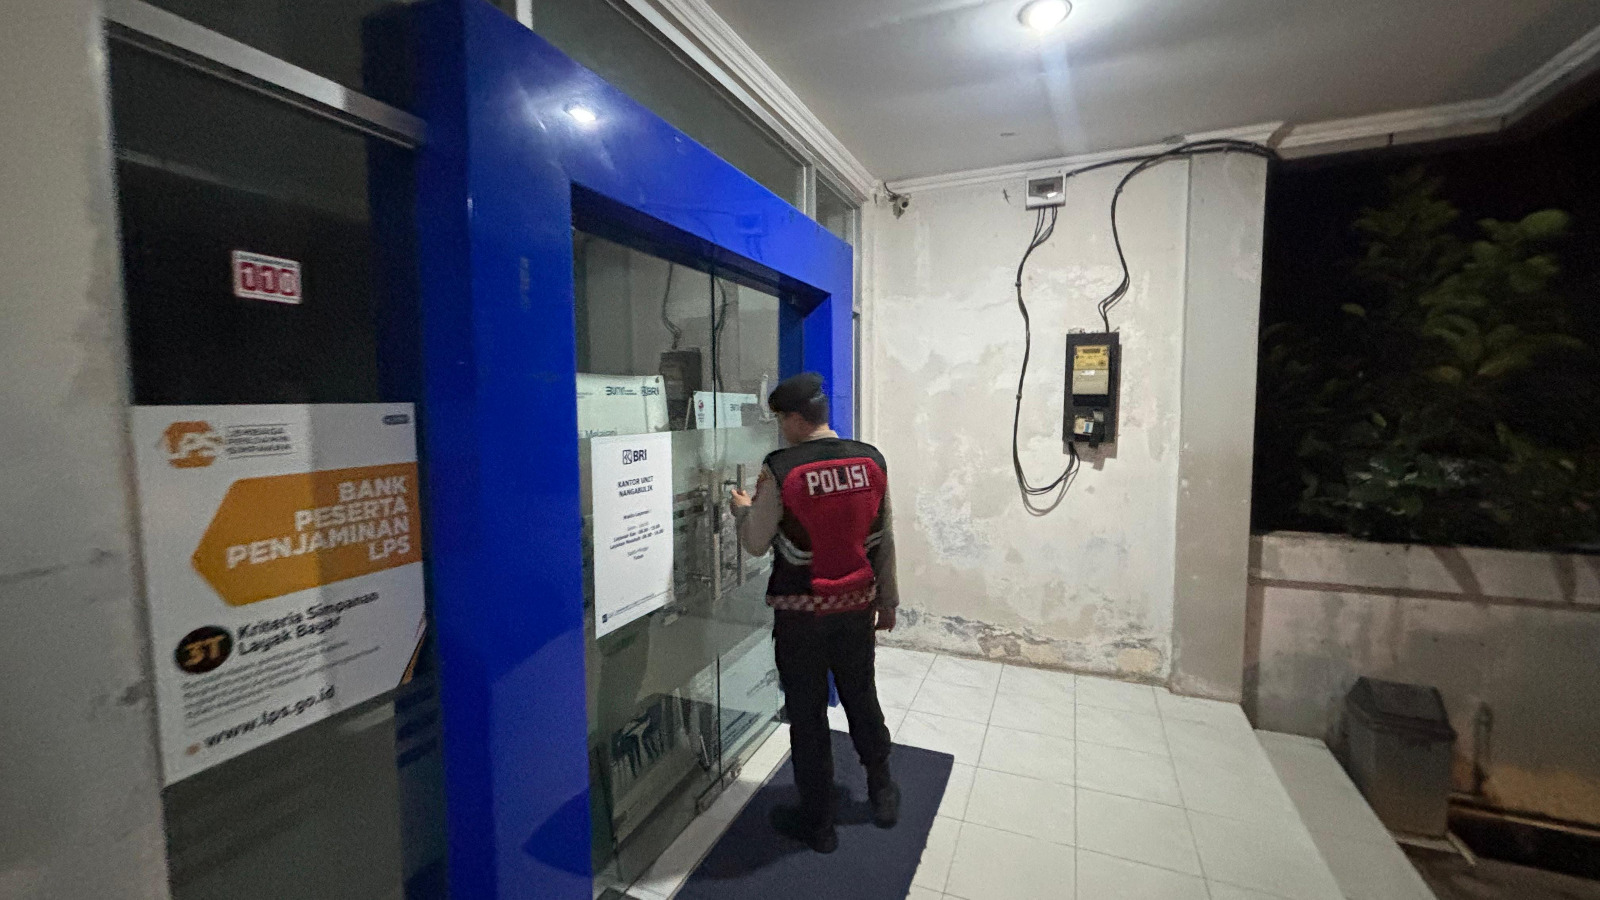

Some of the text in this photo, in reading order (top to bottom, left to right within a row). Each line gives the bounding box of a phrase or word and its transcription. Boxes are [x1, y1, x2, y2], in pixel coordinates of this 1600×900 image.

[633, 449, 647, 462] BRI
[338, 475, 407, 501] BANK
[617, 478, 640, 488] KANTOR
[805, 464, 871, 497] POLISI
[294, 496, 408, 532] PESERTA
[226, 515, 410, 570] PENJAMINAN
[368, 535, 411, 561] LPS
[237, 611, 302, 639] Kriteria
[183, 635, 226, 667] 3T
[203, 684, 336, 747] www.lps.go.id
